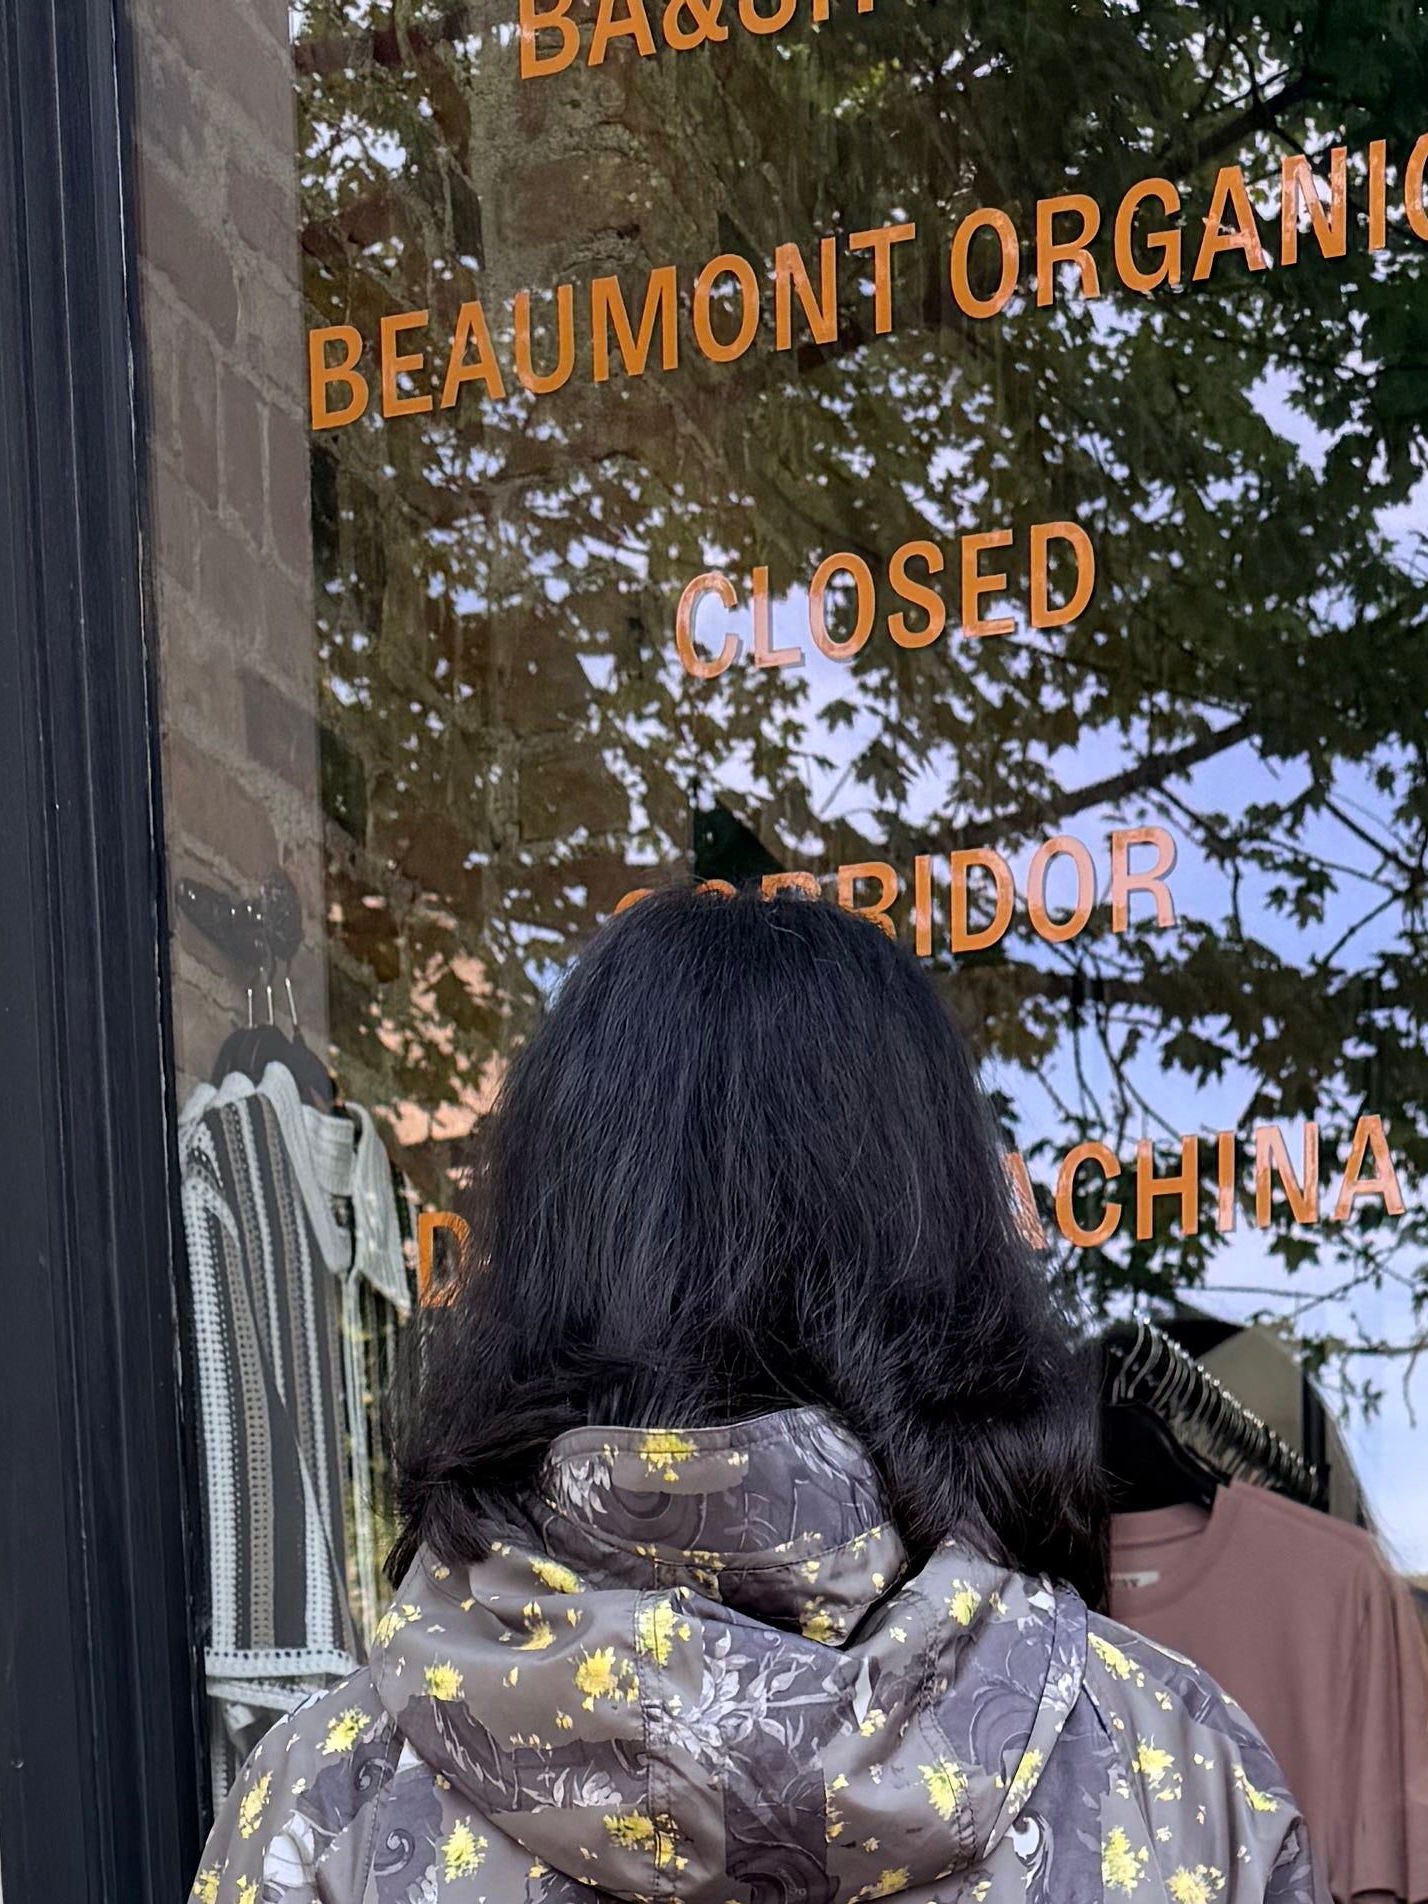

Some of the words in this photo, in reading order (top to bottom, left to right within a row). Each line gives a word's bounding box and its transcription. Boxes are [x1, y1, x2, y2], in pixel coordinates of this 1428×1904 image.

[308, 222, 916, 431] BEAUMONT
[674, 520, 1098, 680] CLOSED
[613, 826, 1178, 957] RIDOR
